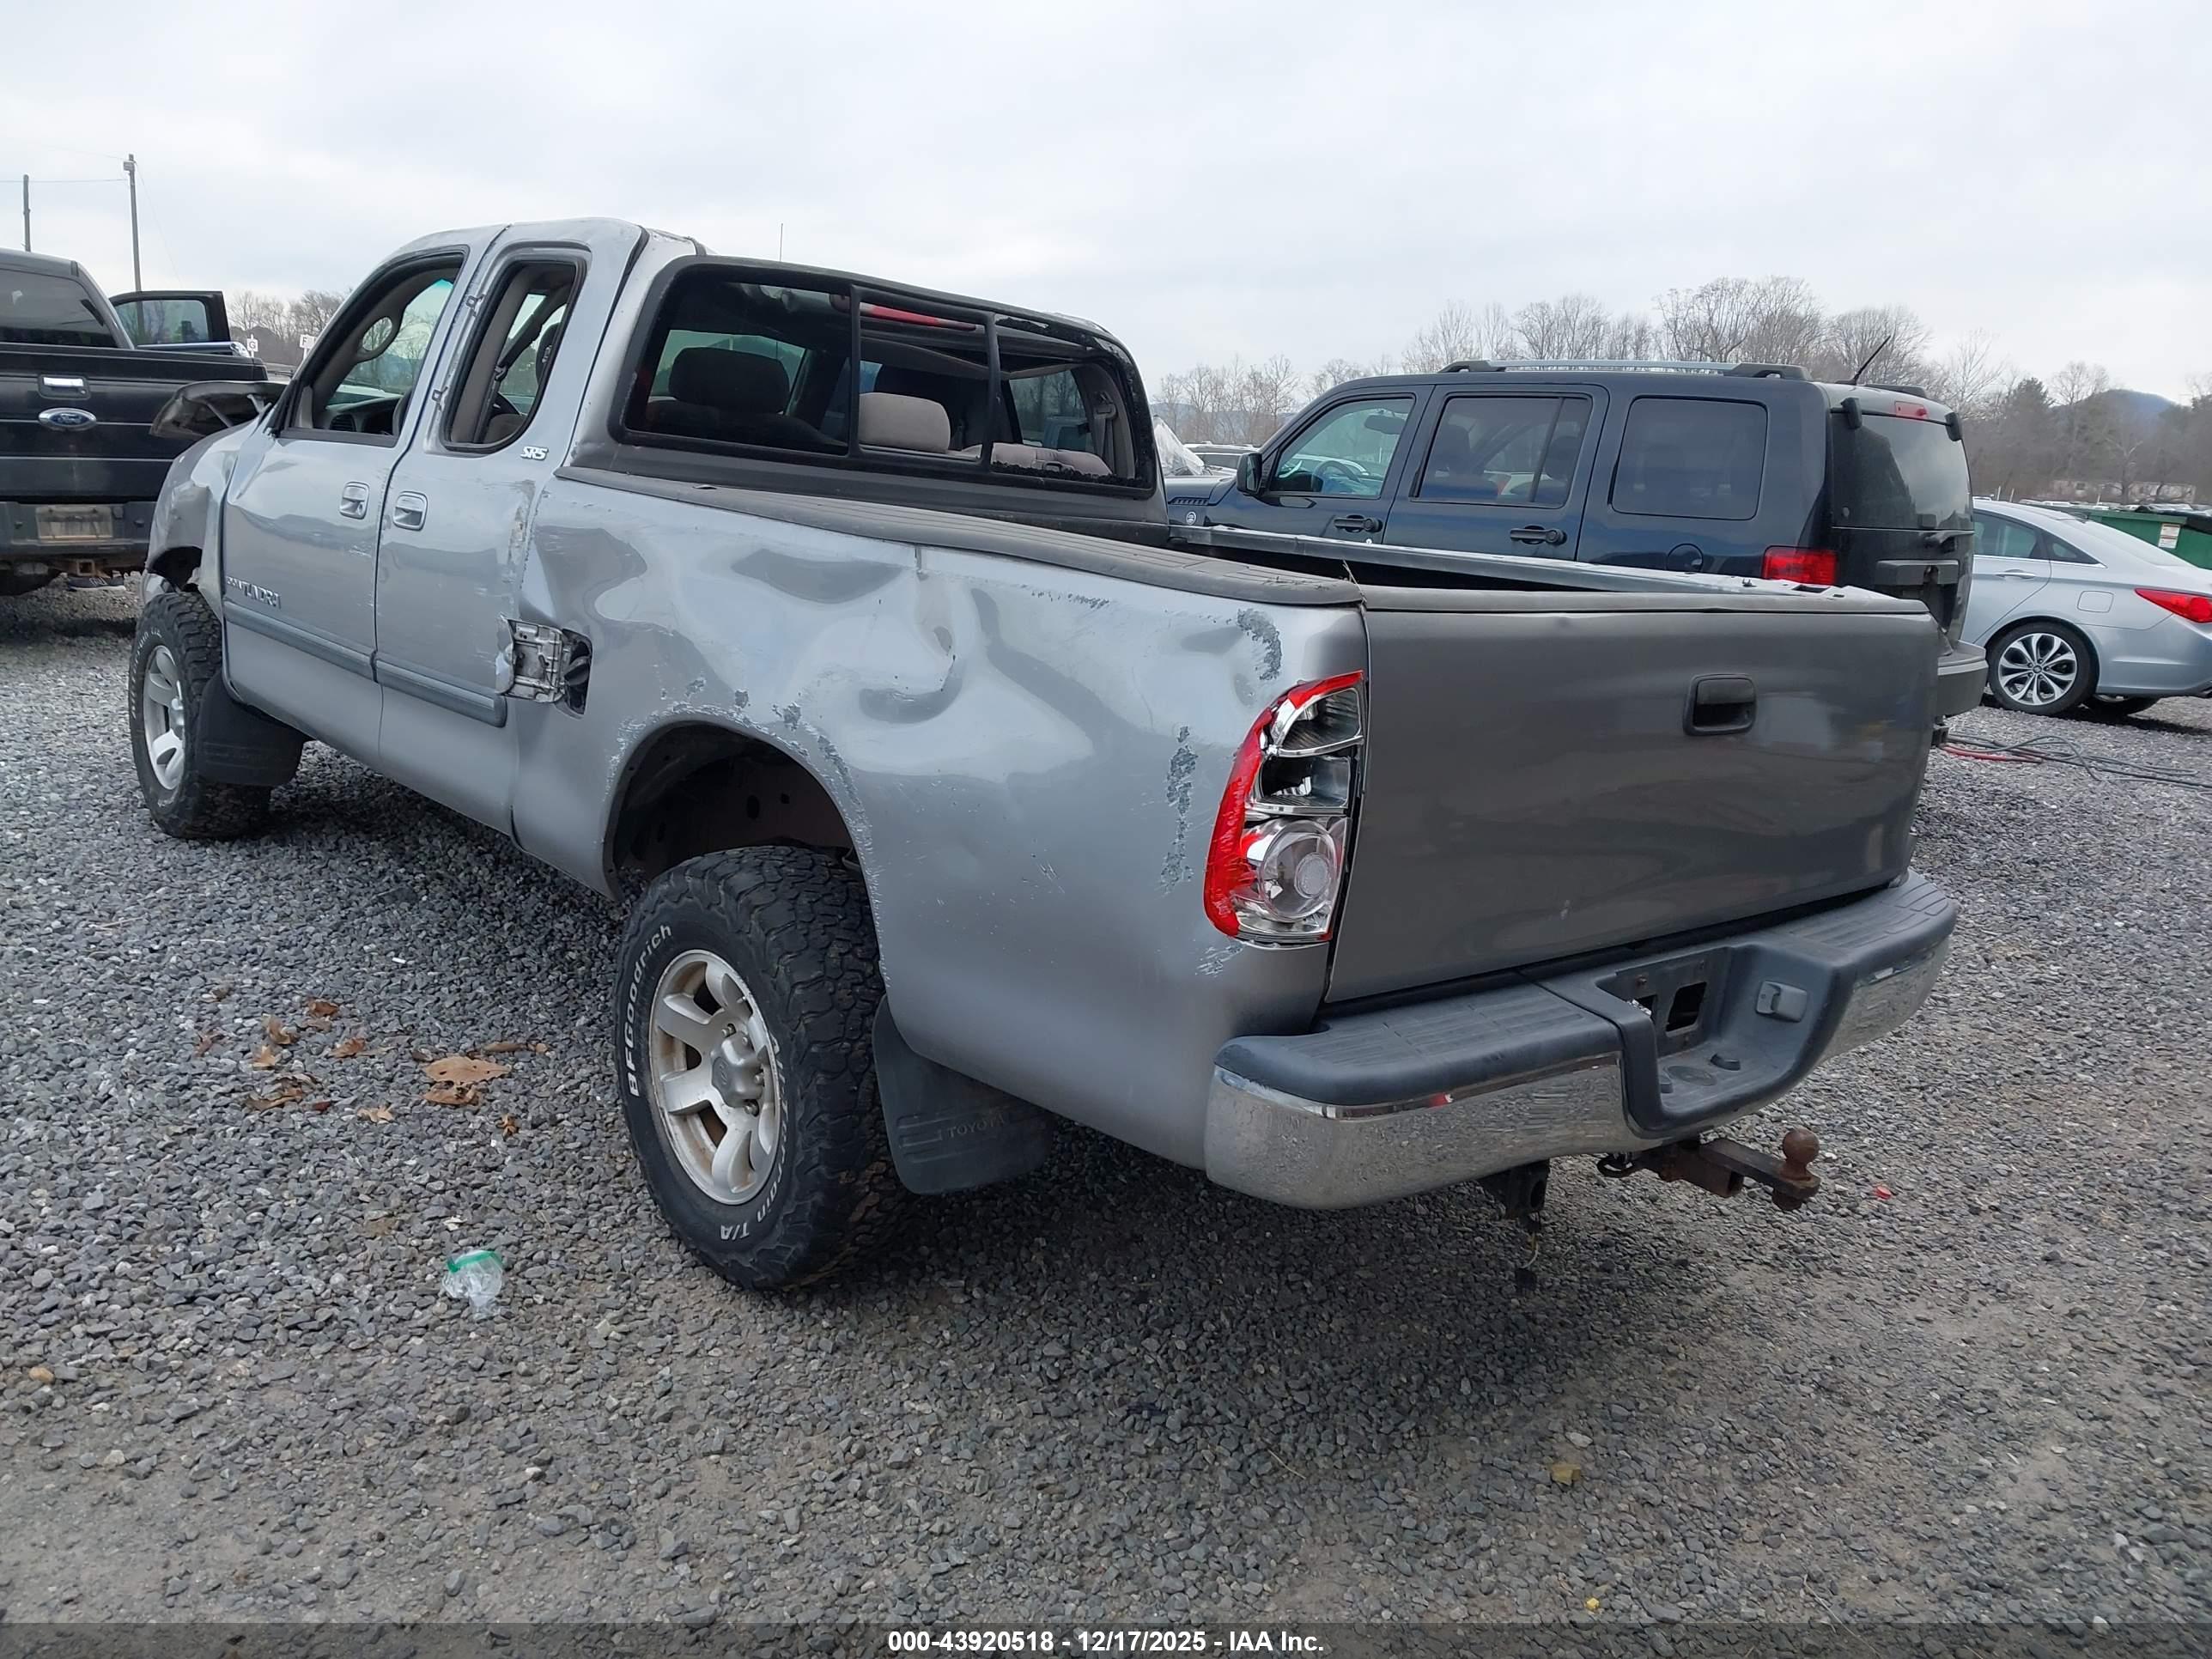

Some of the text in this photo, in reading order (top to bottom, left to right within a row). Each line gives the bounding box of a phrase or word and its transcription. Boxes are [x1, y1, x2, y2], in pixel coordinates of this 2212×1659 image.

[624, 924, 672, 1097] BFGoodrich
[947, 1110, 1005, 1138] TOYOTA
[720, 1222, 750, 1240] T/A
